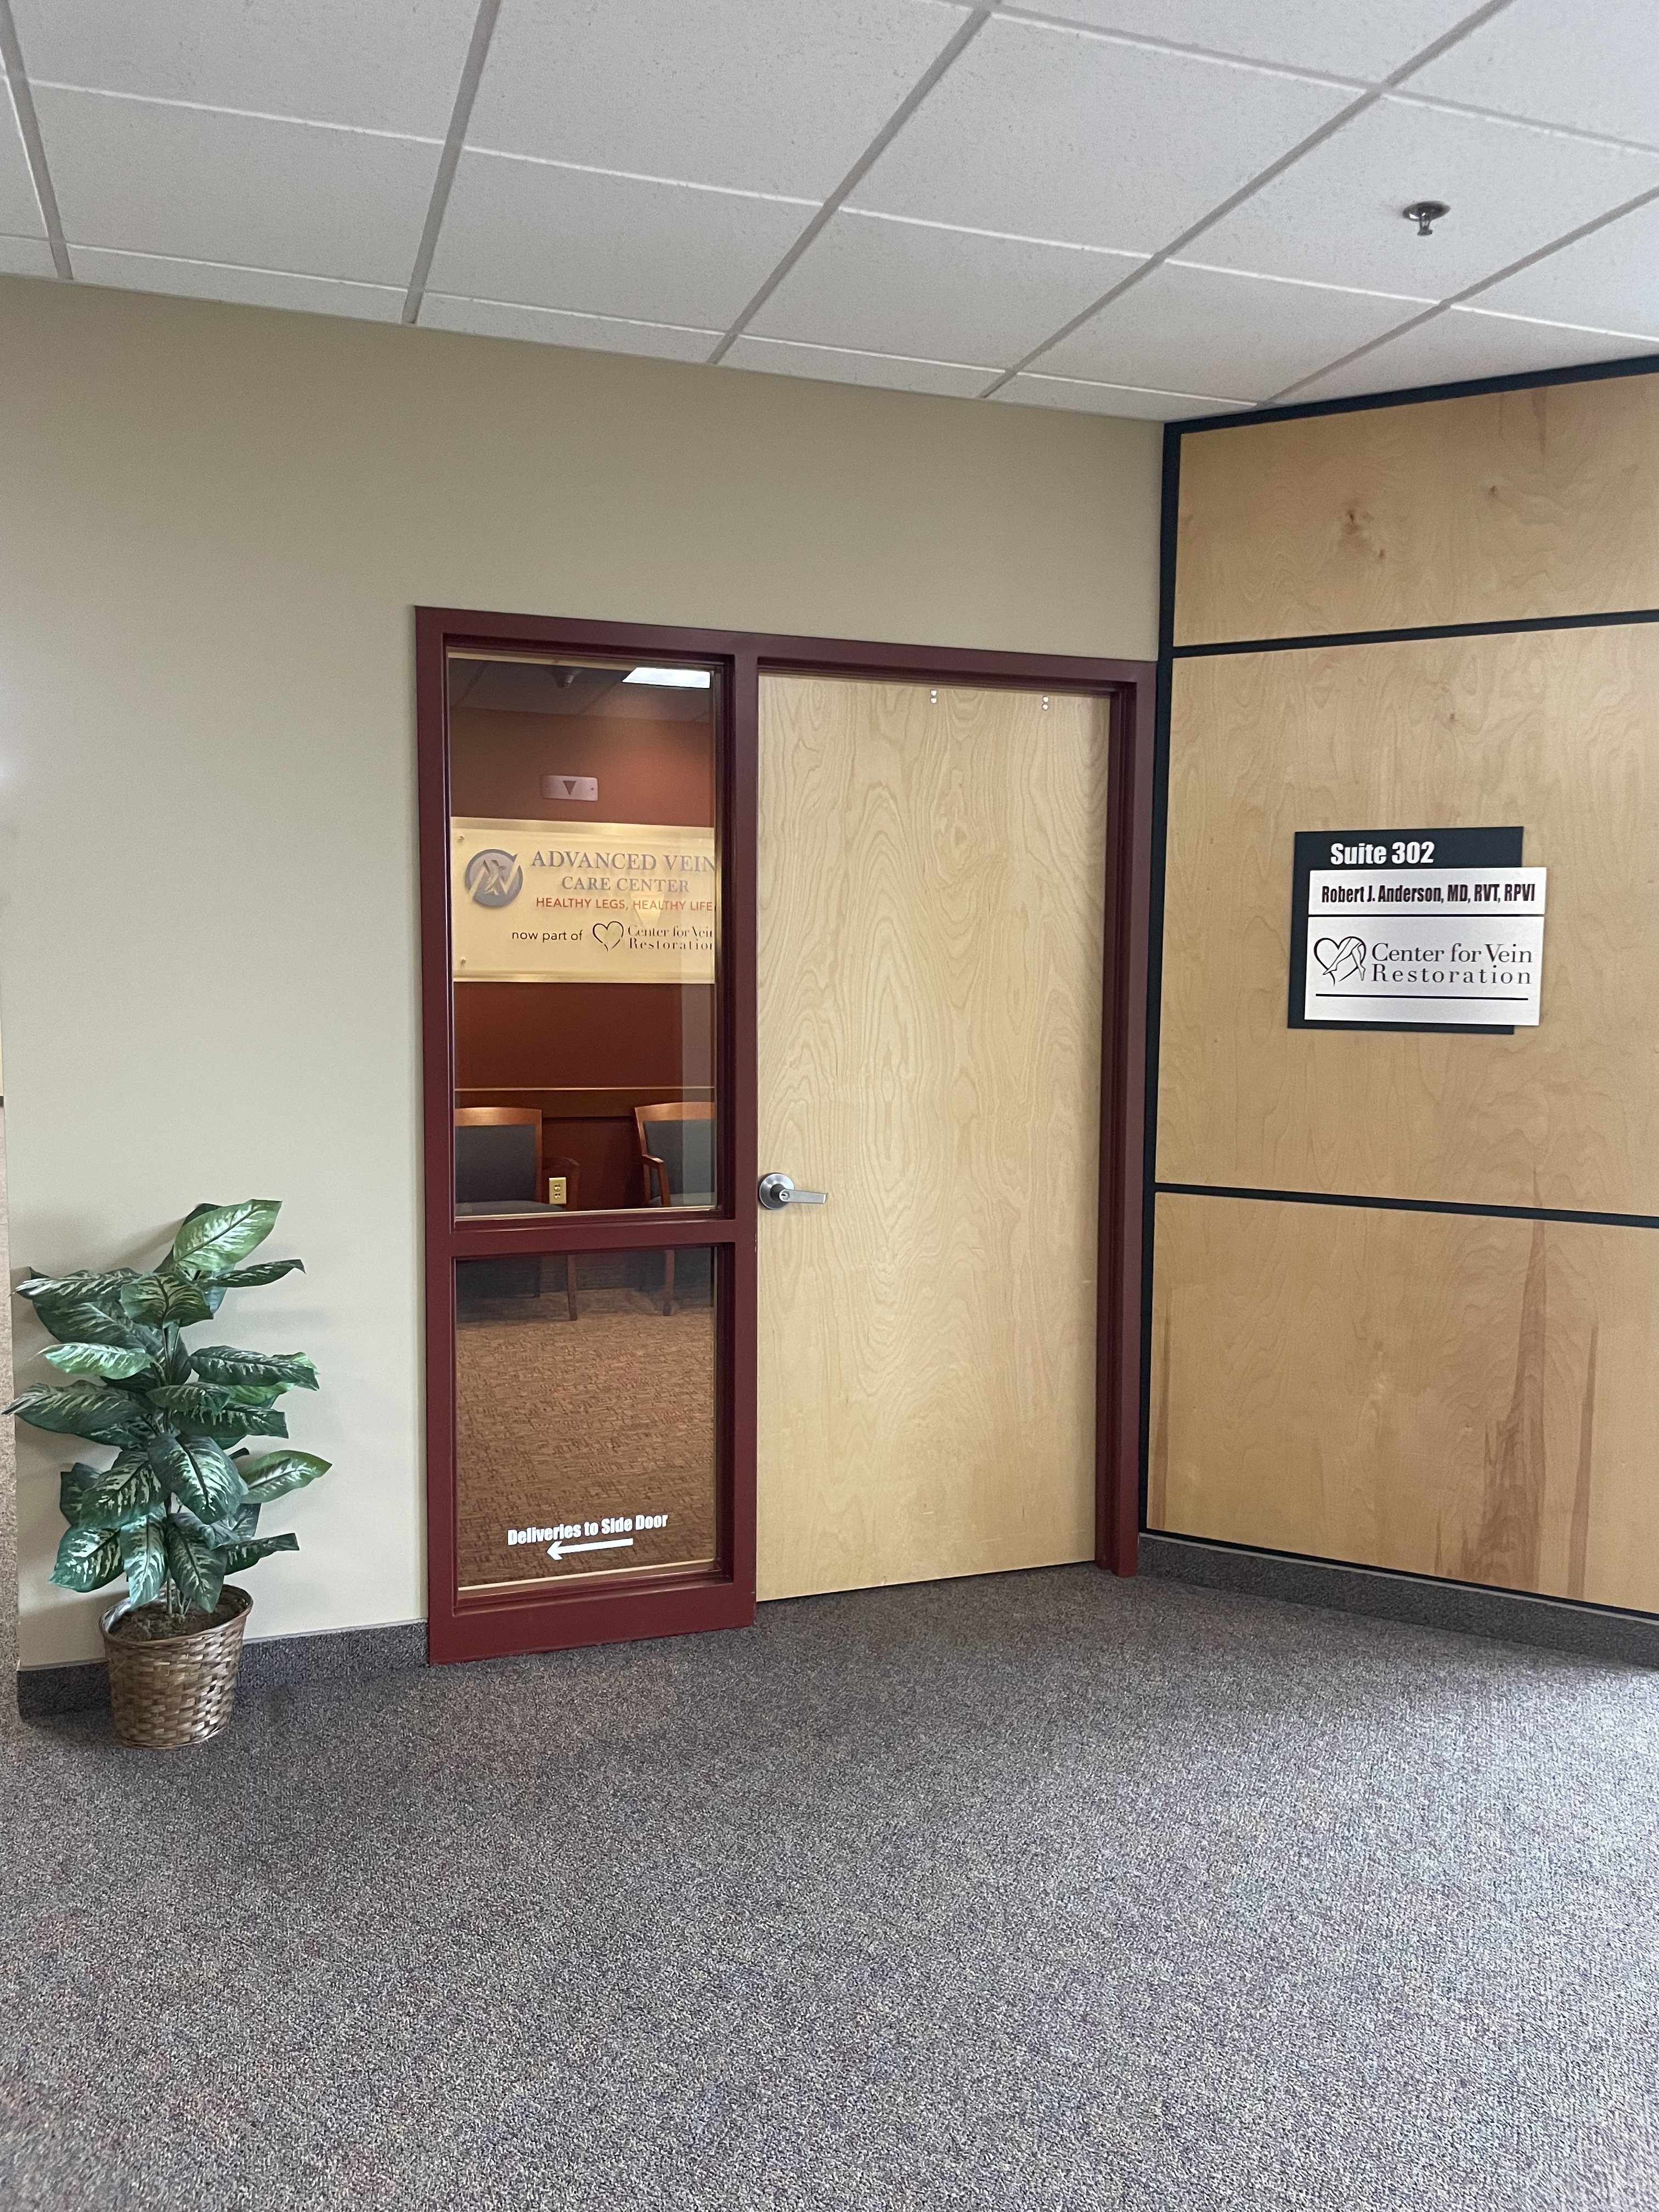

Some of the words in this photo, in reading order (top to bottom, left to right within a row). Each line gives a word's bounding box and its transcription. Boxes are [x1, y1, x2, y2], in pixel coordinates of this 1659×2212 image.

[530, 850, 657, 871] ADVANCED
[663, 855, 715, 872] VEIN
[1330, 842, 1387, 865] Suite
[1391, 841, 1435, 864] 302
[561, 876, 611, 891] CARE
[616, 878, 690, 893] CENTER
[1321, 885, 1365, 903] Robert
[1367, 885, 1376, 902] J.
[1378, 884, 1444, 904] Anderson,
[1447, 884, 1471, 904] MD,
[1474, 884, 1502, 904] RVT,
[1504, 883, 1536, 902] RPVI
[536, 897, 591, 909] HEALTHY
[596, 900, 629, 911] LEGS,
[633, 901, 686, 911] HEALTHY
[690, 901, 713, 911] LIFE
[512, 928, 538, 940] now
[543, 929, 568, 941] part
[571, 930, 583, 940] of
[628, 924, 669, 938] Center
[673, 926, 690, 938] for
[1372, 943, 1444, 962] Center
[1451, 943, 1481, 962] for
[1485, 944, 1533, 963] Vein
[1371, 963, 1532, 984] Restoration
[507, 1523, 582, 1545] Deliveries
[584, 1521, 599, 1536] to
[601, 1517, 633, 1534] Side
[635, 1514, 668, 1530] Door
